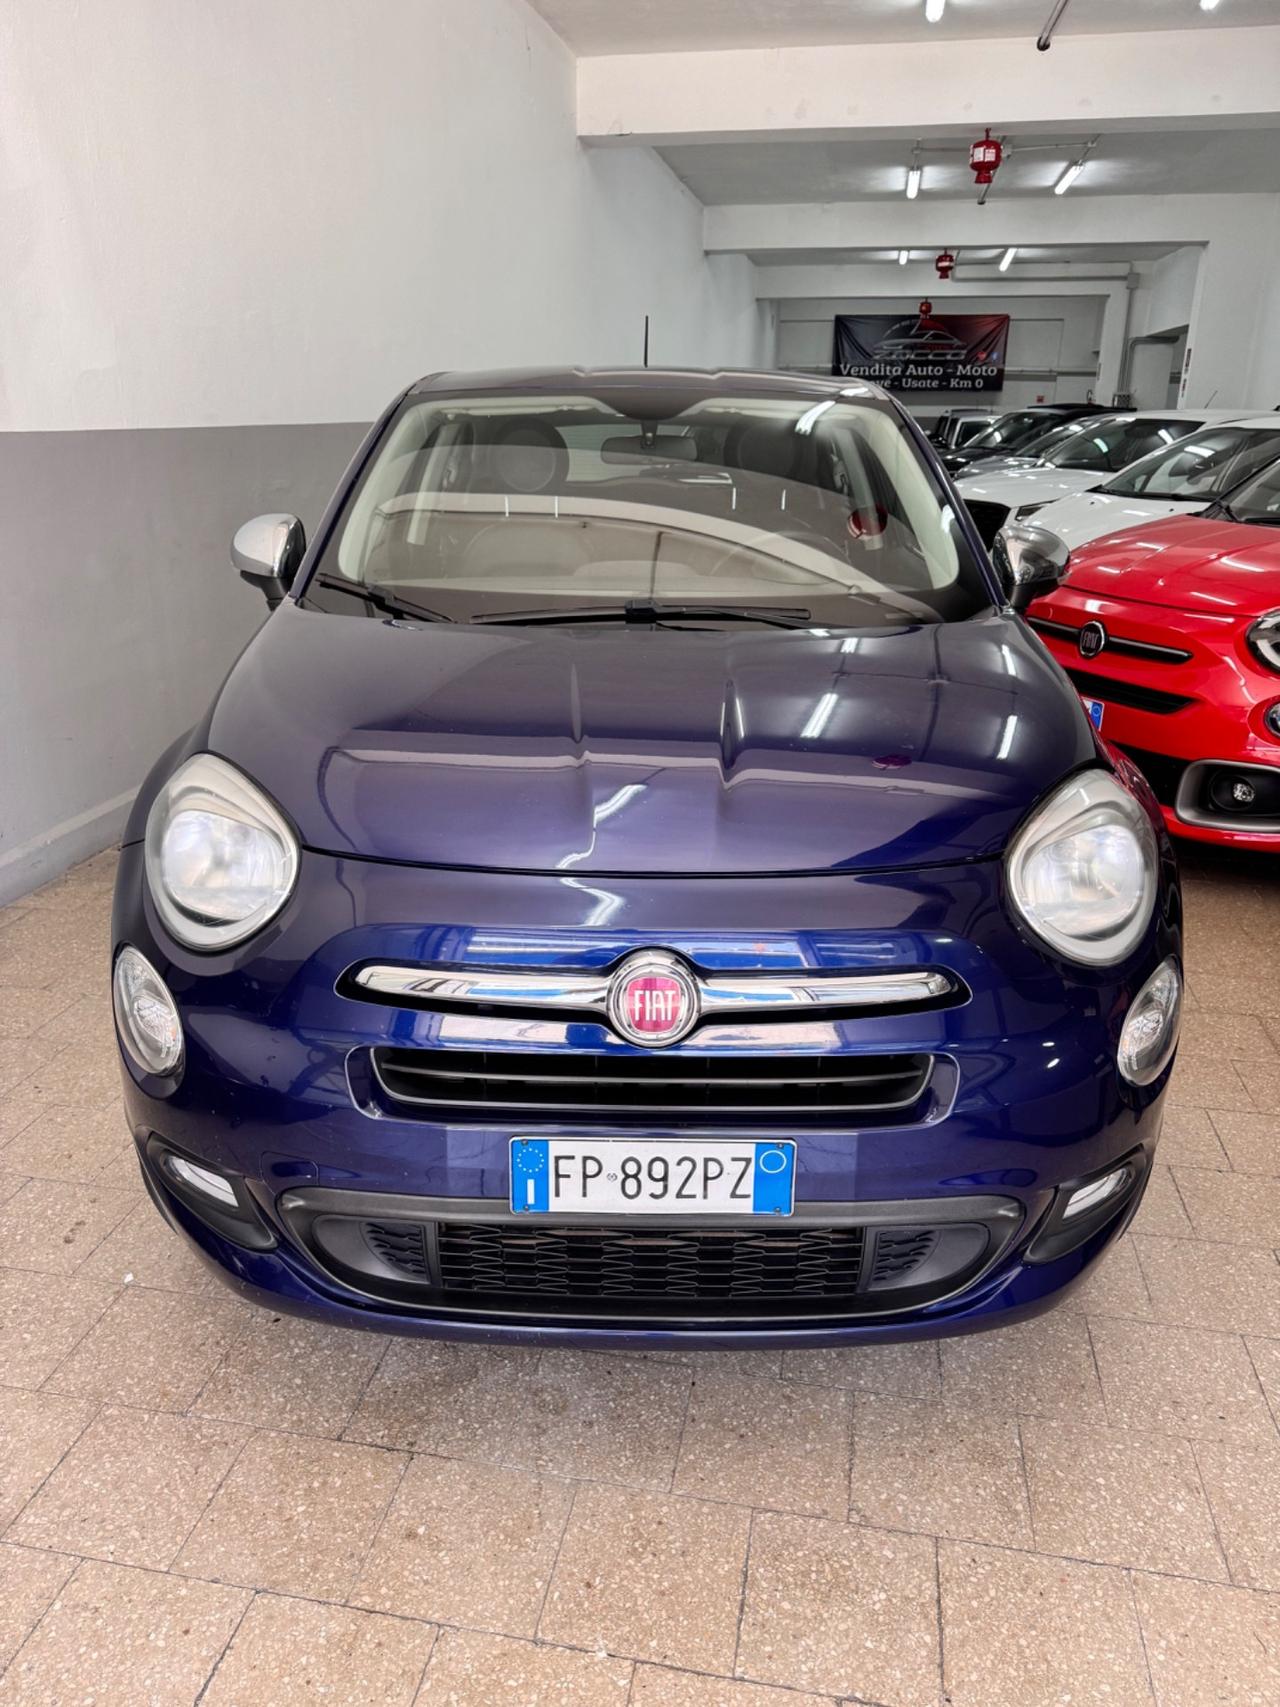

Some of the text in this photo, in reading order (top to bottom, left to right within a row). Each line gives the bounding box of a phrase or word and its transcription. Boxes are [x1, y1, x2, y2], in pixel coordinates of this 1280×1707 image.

[839, 364, 902, 376] Vendita
[905, 364, 943, 376] Auto
[956, 364, 997, 376] Moto
[902, 378, 939, 388] Usate
[950, 378, 972, 388] Km
[634, 989, 676, 1021] FIAT
[553, 1154, 753, 1200] FP 892PZ
